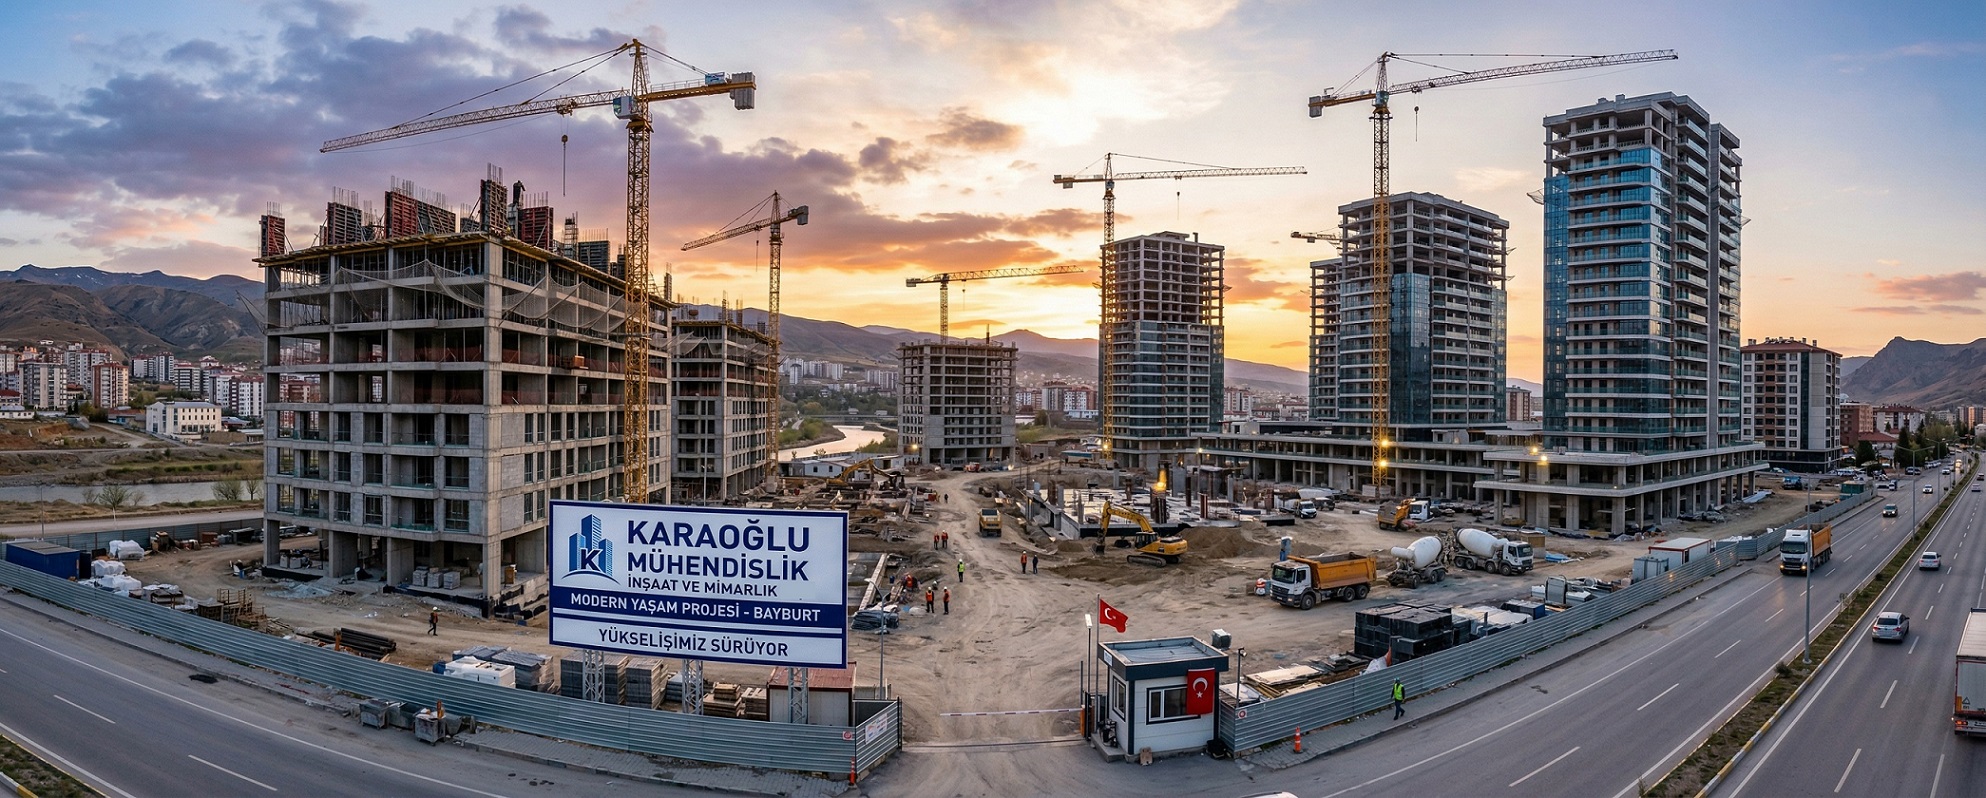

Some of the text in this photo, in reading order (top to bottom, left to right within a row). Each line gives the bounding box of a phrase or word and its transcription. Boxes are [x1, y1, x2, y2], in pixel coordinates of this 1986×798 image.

[627, 519, 810, 552] KARAOĞLU
[580, 548, 603, 571] K
[627, 549, 809, 581] MÜHENDİSLİK
[628, 574, 778, 597] İNŞAAT VE MİMARLIK
[571, 593, 628, 610] MODERN
[631, 599, 678, 615] YAŞAM
[682, 602, 740, 618] PROJESİ
[754, 607, 821, 622] BAYBURT
[598, 627, 788, 657] YÜKSELİŞİMİZ SÜRÜYOR
